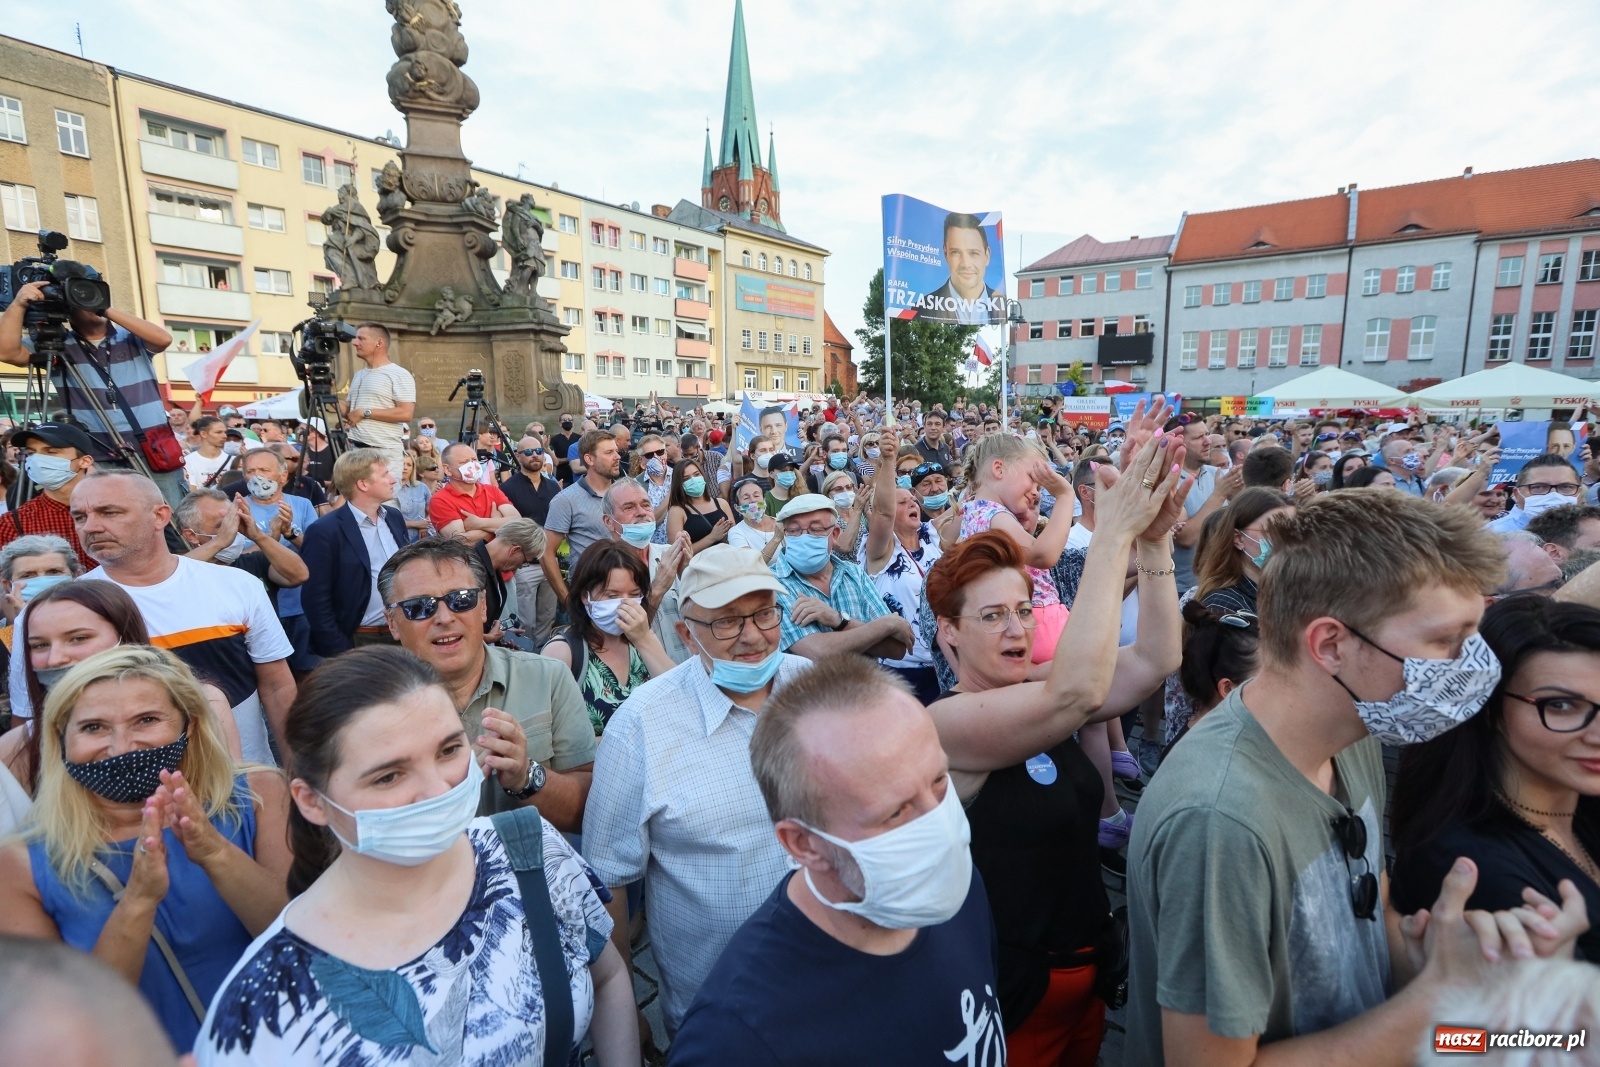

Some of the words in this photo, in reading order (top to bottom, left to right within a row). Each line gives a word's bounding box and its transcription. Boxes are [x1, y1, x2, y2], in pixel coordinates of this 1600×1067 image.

[886, 236, 906, 247] Silny
[907, 239, 940, 254] Prezydent
[887, 247, 919, 260] Wspólna
[920, 253, 942, 266] Polska
[887, 280, 909, 288] RAFAŁ
[887, 288, 1005, 312] TRZASKOWSKI
